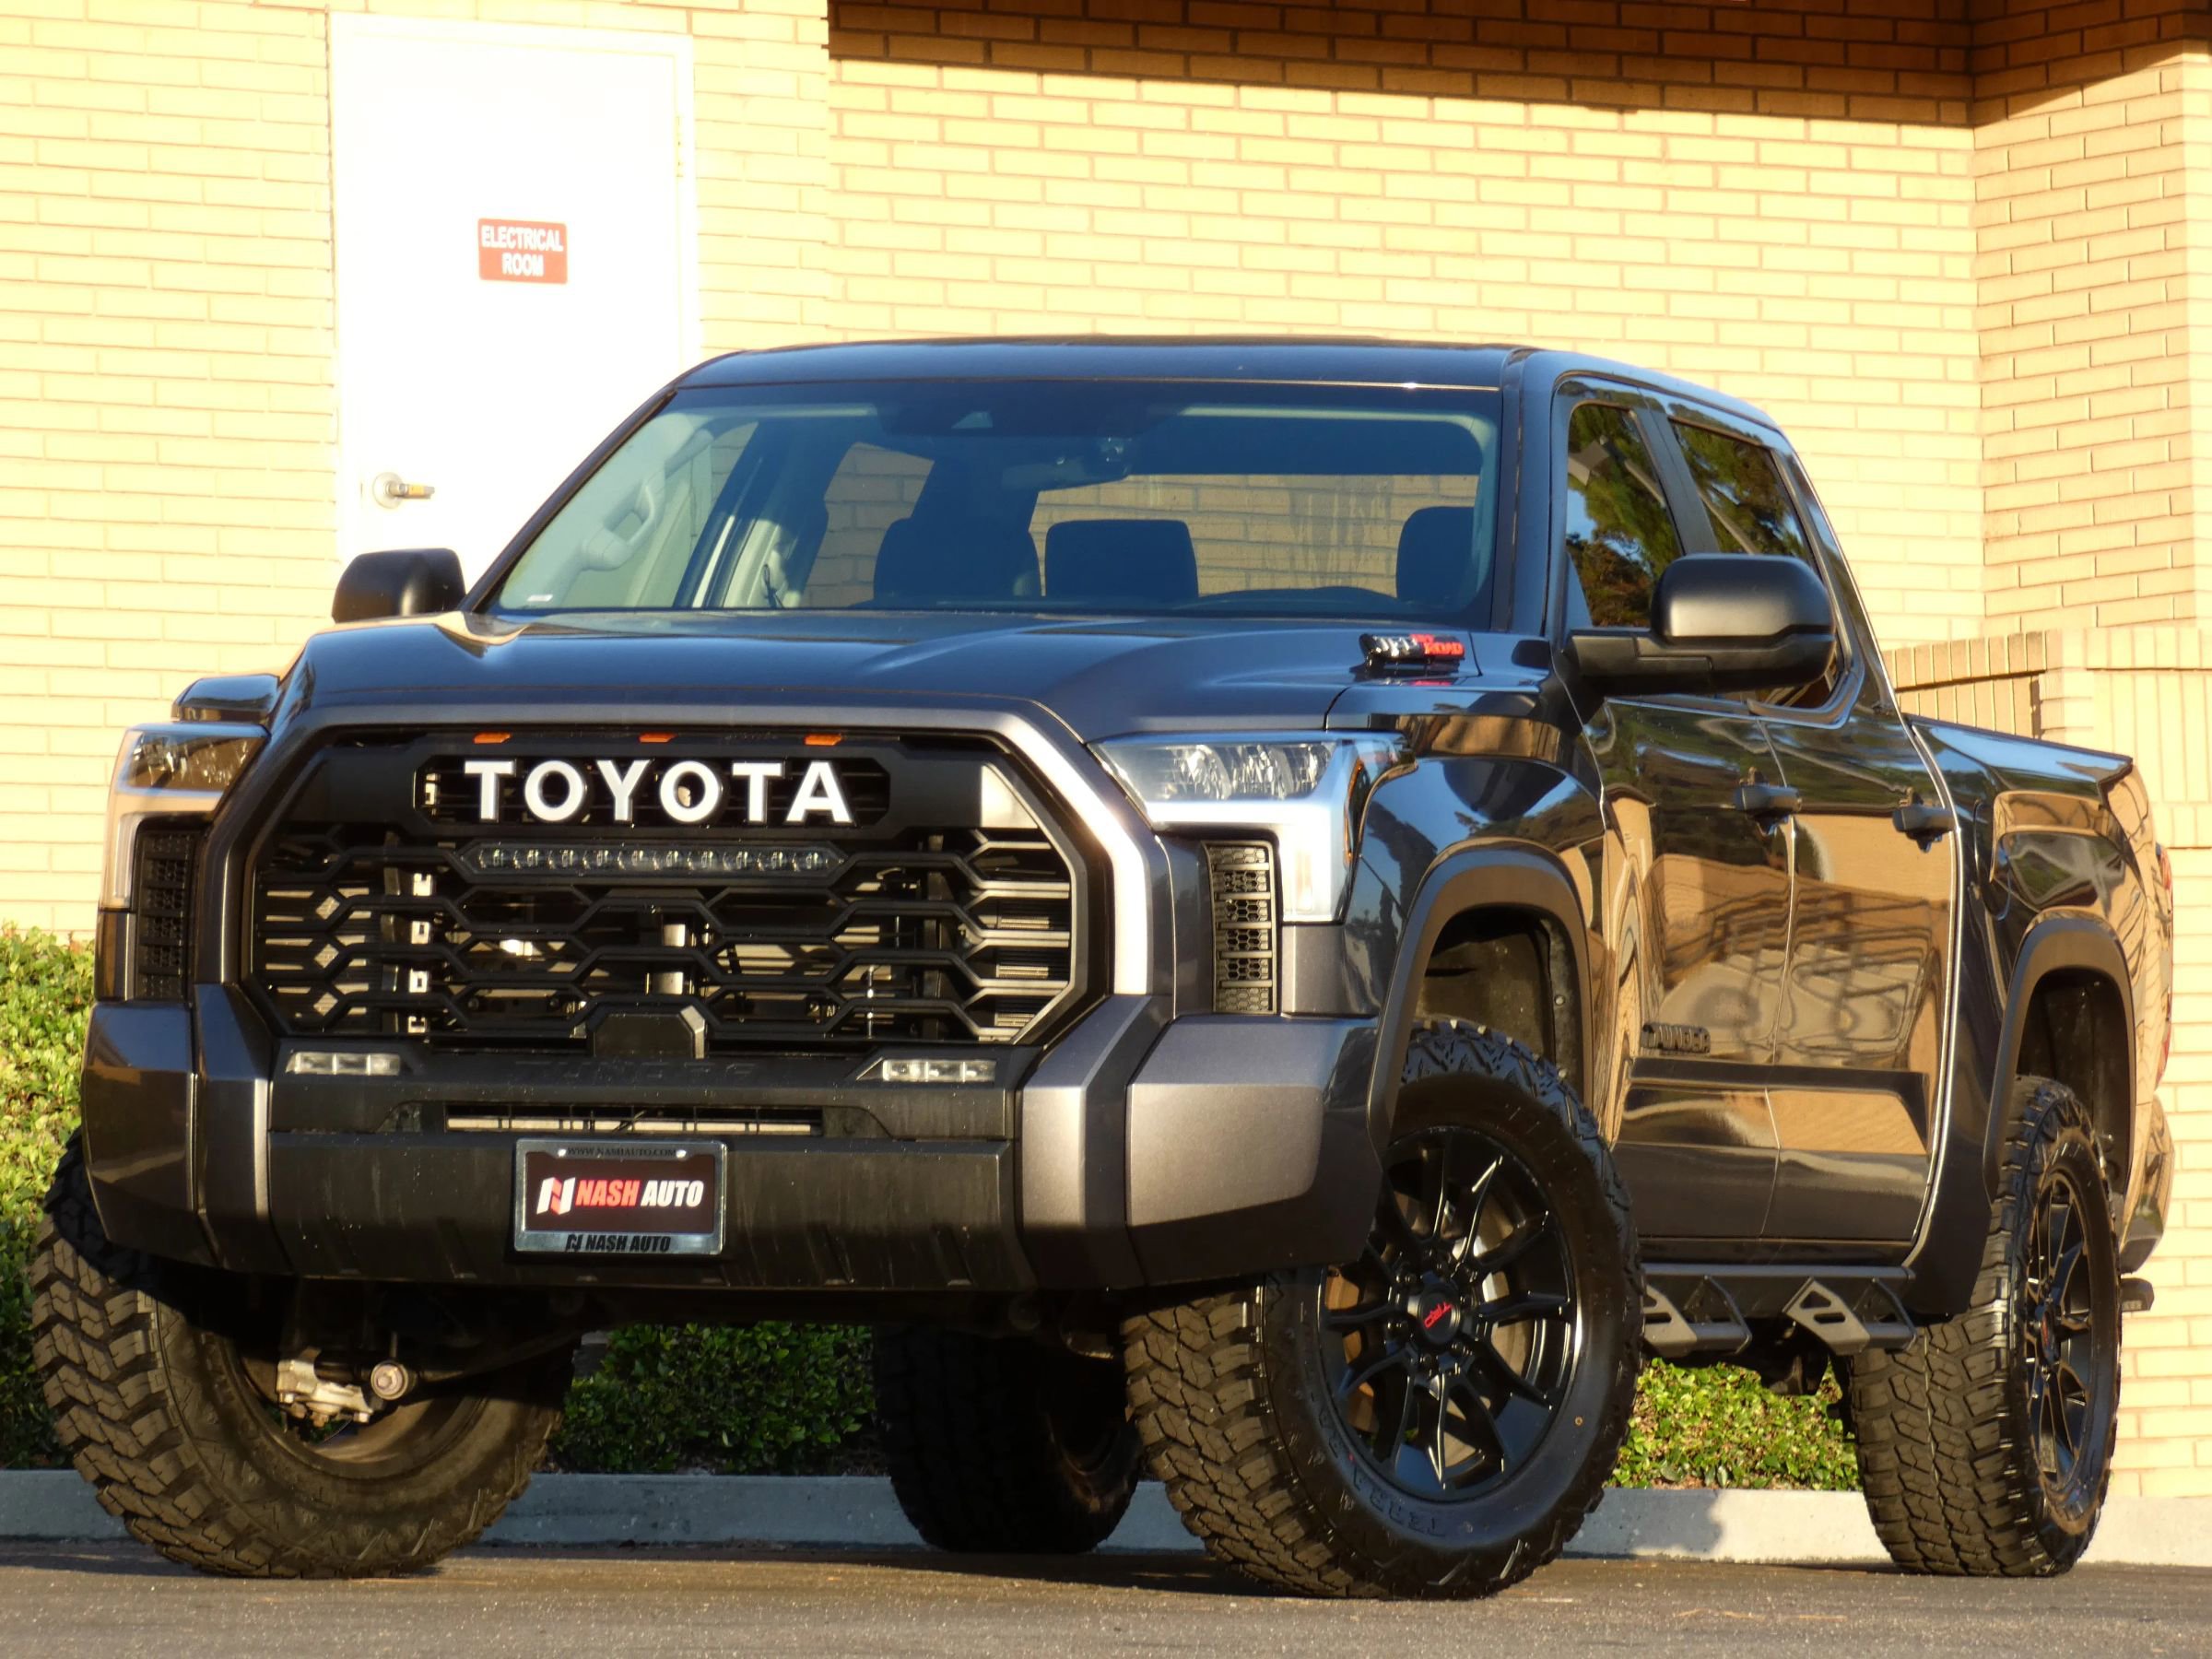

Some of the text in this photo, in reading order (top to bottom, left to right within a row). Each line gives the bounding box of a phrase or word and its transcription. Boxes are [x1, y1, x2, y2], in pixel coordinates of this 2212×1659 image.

[481, 225, 564, 252] ELECTRICAL
[501, 252, 544, 276] ROOM
[464, 759, 853, 823] TOYOTA
[575, 1180, 641, 1206] NASH
[641, 1180, 704, 1207] AUTO
[585, 1234, 629, 1251] NASH
[629, 1236, 671, 1253] AUTO
